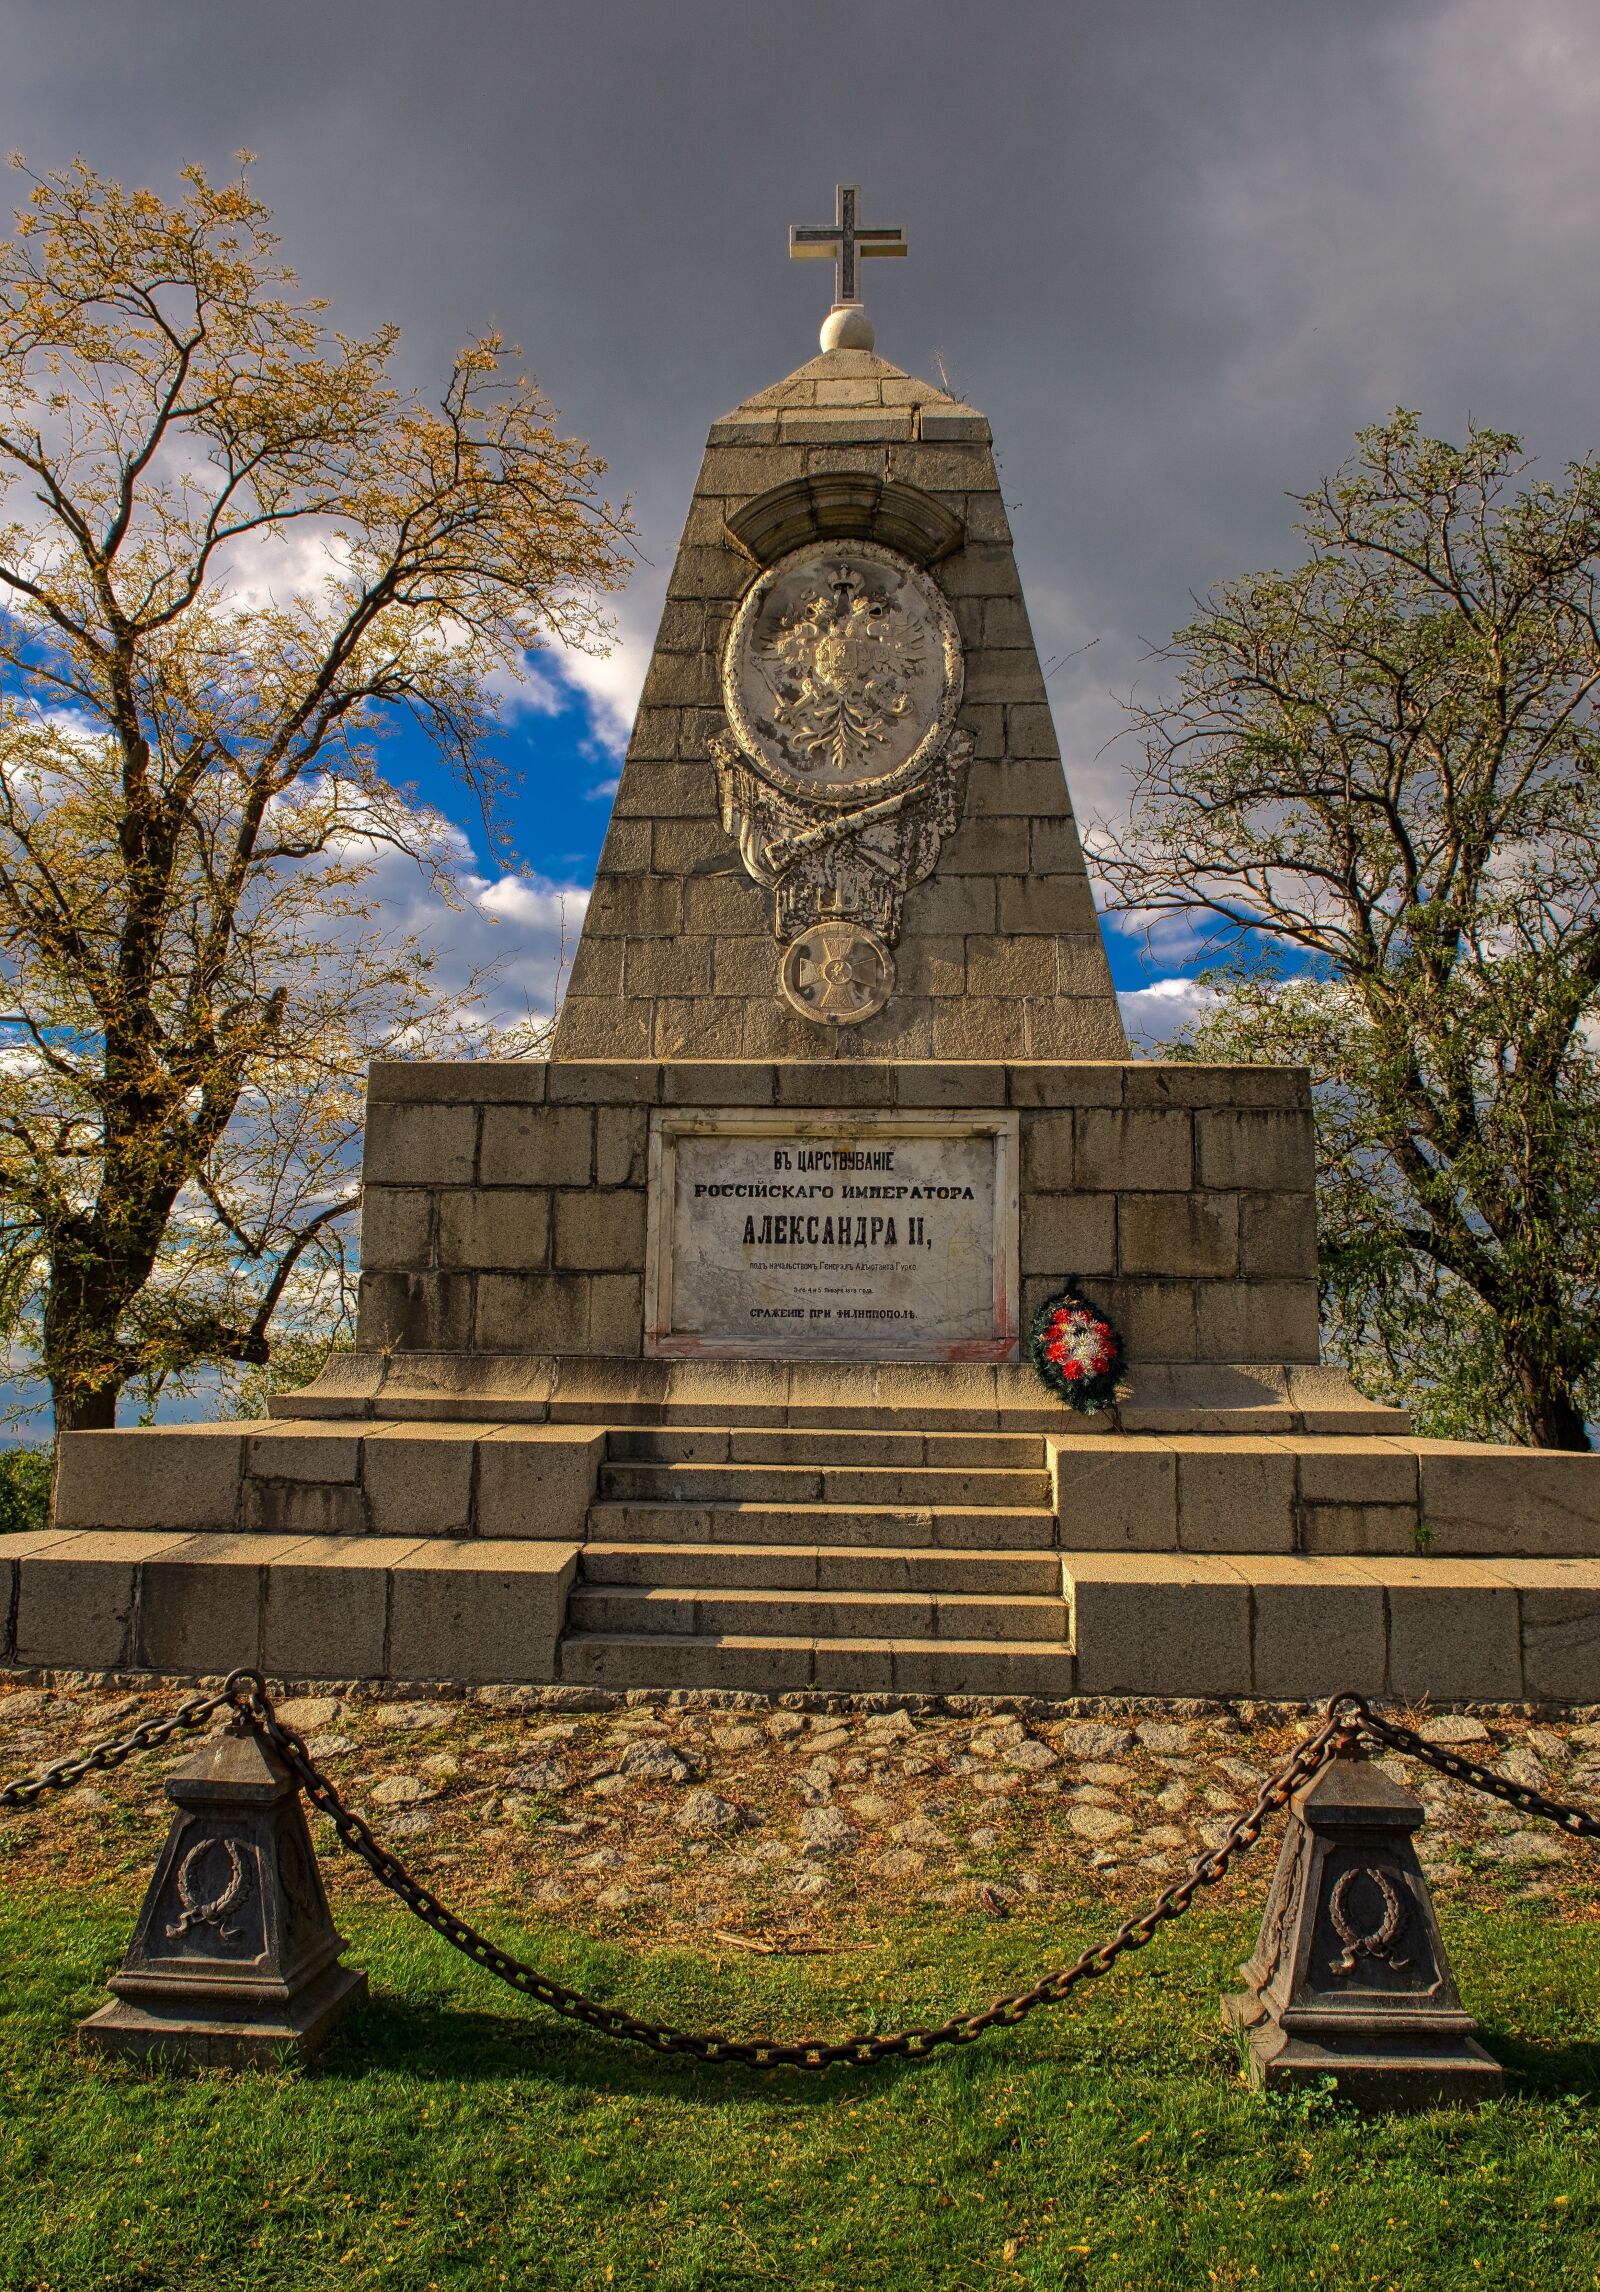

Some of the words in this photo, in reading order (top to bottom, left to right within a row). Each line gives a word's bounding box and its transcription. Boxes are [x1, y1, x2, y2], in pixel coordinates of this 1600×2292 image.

[774, 1151, 792, 1171] ВЪ
[694, 1180, 834, 1200] РОССІЙСКАГО
[842, 1184, 975, 1200] ИМПЕРАТОРА
[742, 1215, 898, 1248] АЛЕКСАНДРА
[809, 1309, 831, 1318] ПРИ
